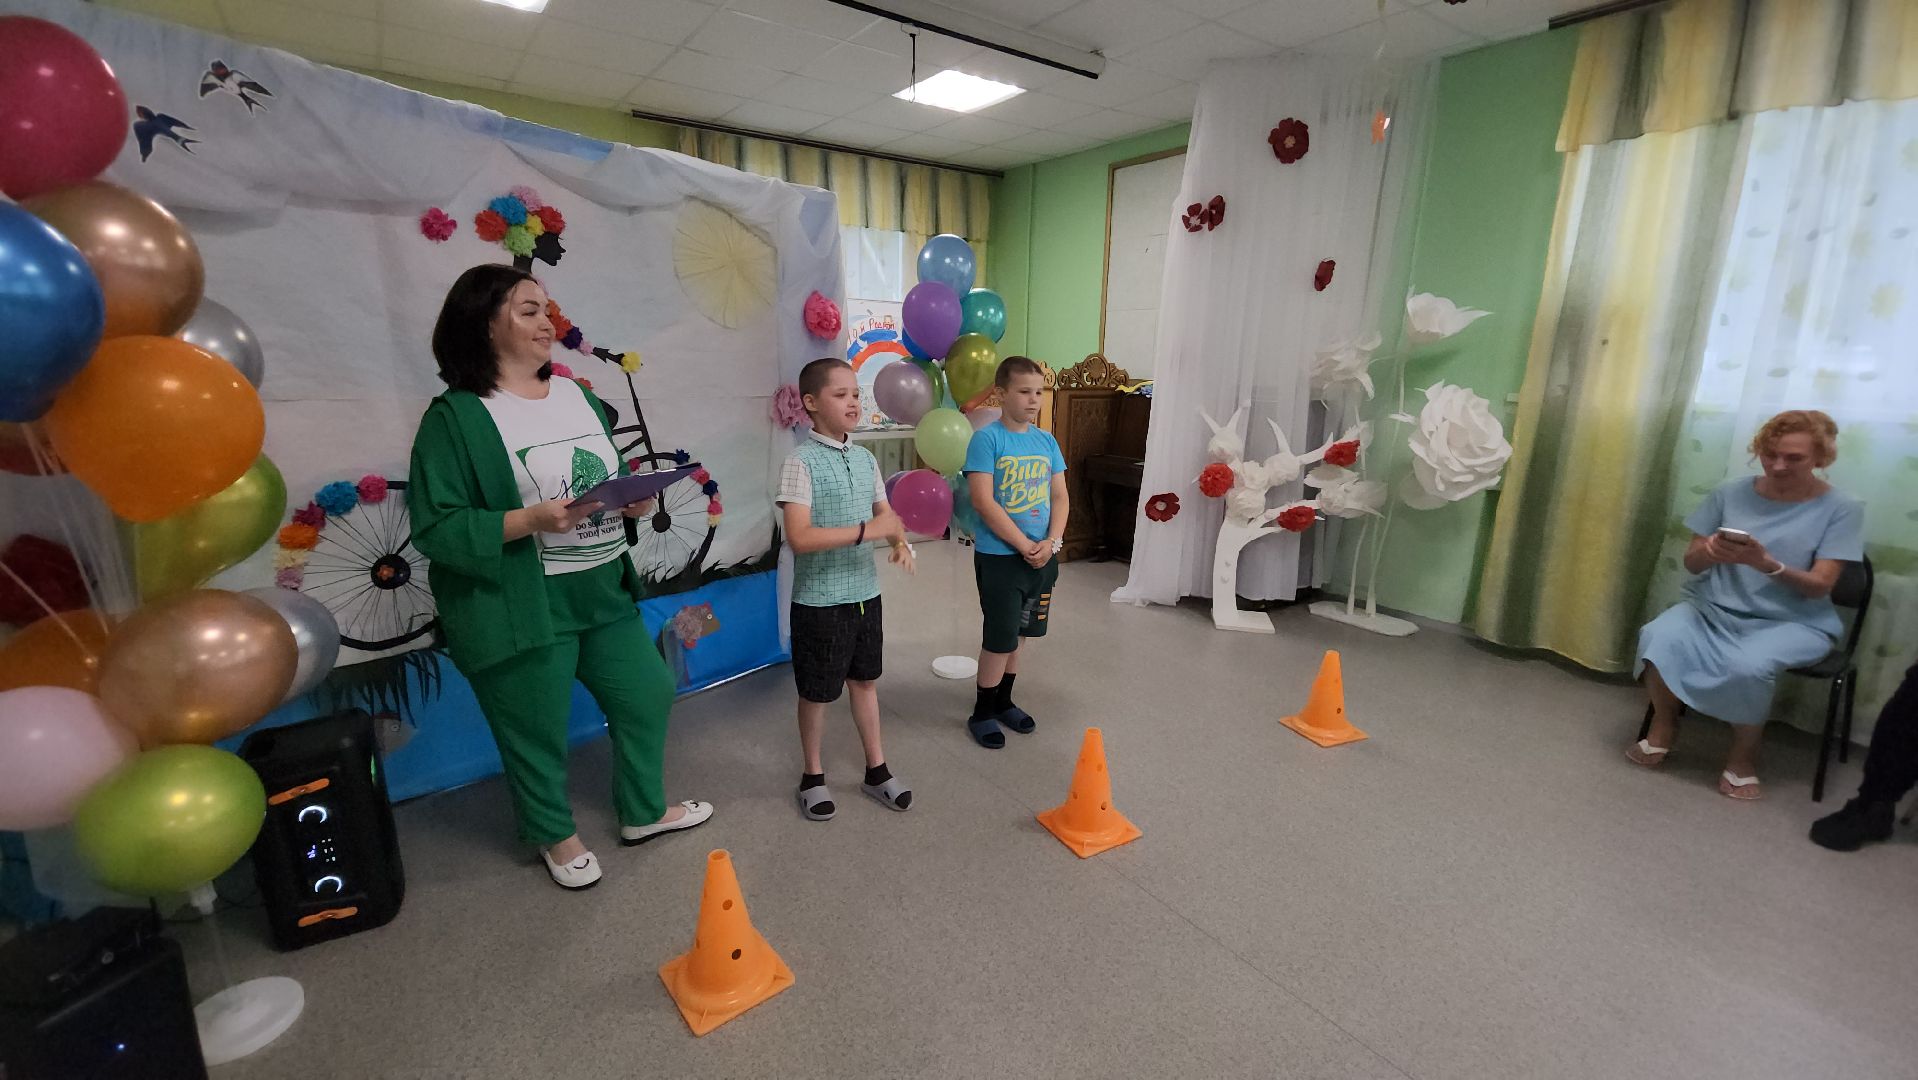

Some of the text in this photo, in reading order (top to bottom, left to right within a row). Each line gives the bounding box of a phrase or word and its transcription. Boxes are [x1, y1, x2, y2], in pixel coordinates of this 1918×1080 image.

[575, 516, 622, 531] DO SOETHIN
[600, 525, 617, 535] NOW
